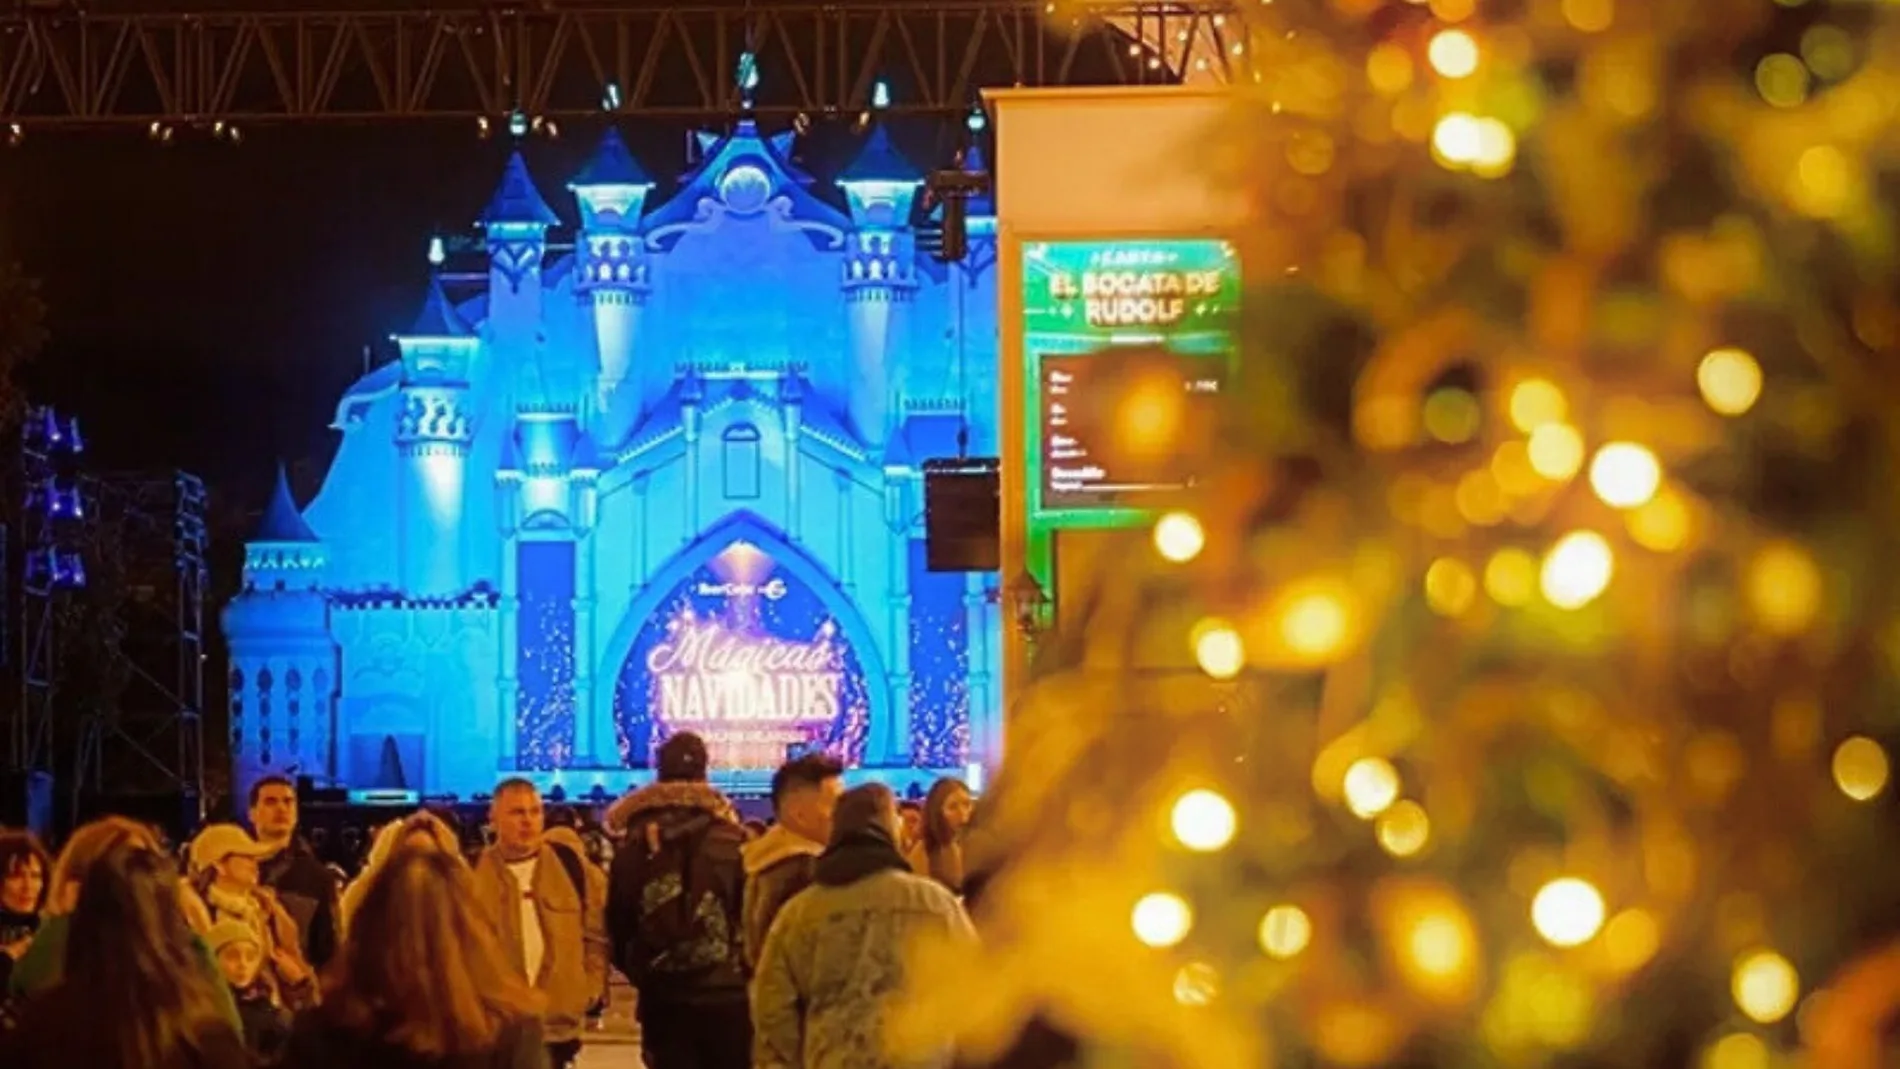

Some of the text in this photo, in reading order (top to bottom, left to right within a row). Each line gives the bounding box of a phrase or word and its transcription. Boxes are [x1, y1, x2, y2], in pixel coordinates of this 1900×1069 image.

[1050, 272, 1079, 297] EL
[1184, 269, 1220, 294] DE
[1086, 297, 1184, 325] RUDOLF
[659, 671, 841, 720] NAVIDADES
